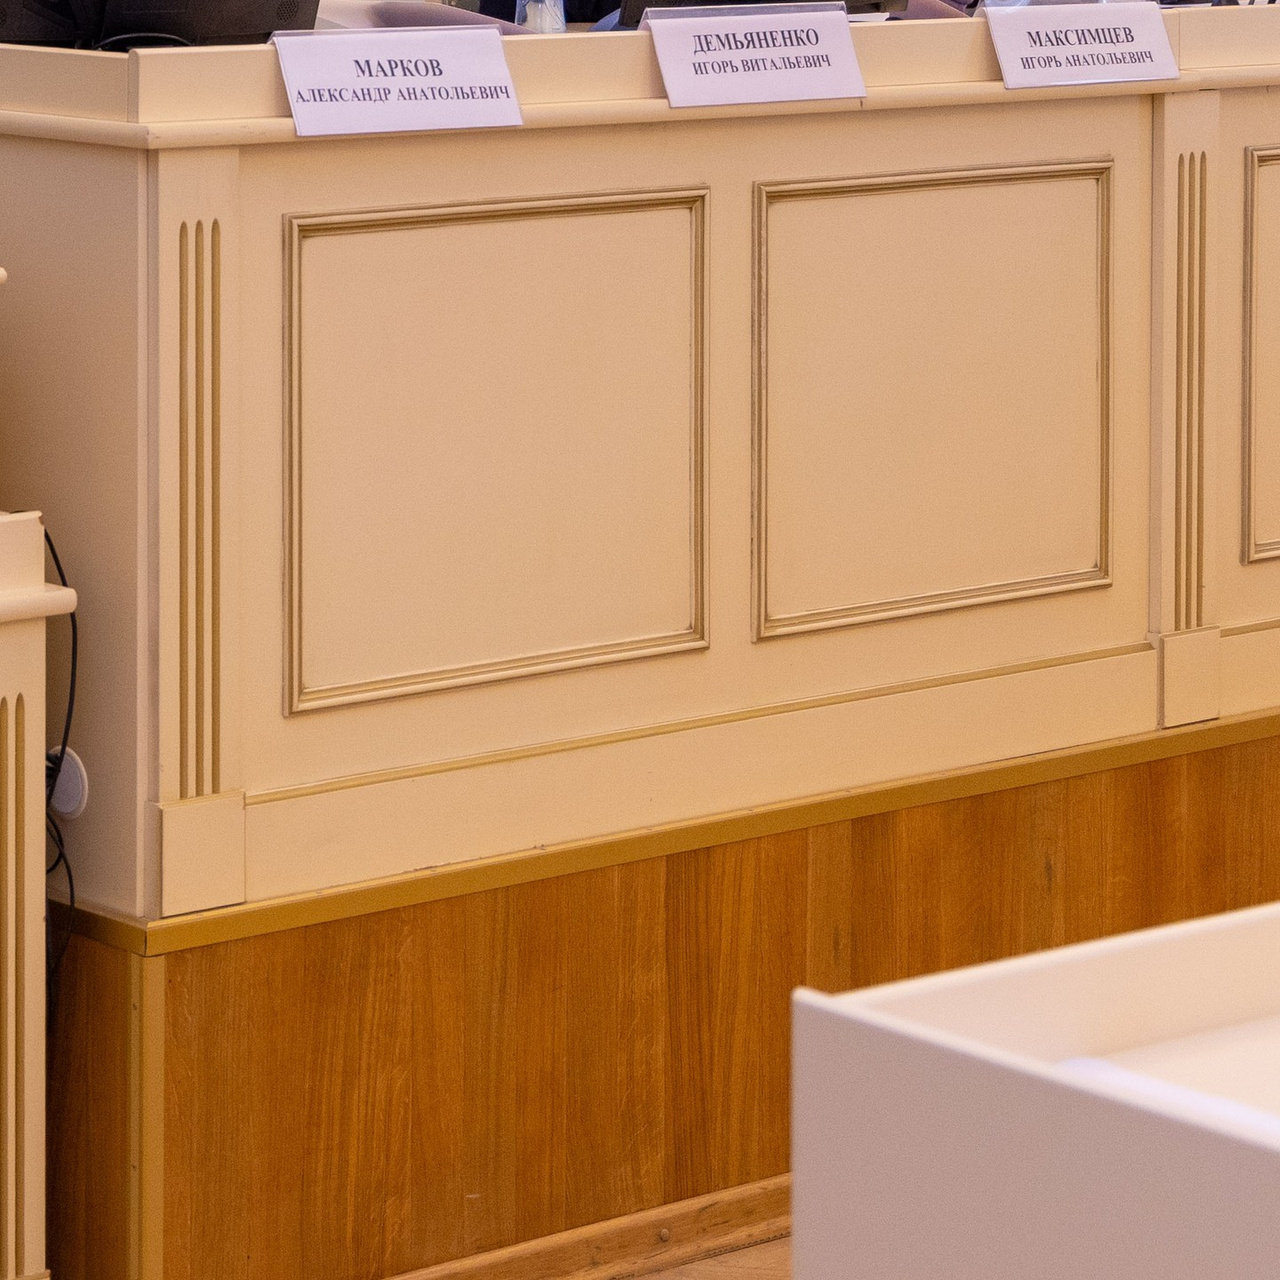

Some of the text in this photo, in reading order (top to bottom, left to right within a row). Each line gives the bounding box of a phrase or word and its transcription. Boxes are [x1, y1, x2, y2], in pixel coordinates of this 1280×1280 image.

[692, 27, 820, 55] ДЕМЬЯНЕНКО
[1026, 26, 1135, 48] МАКСИМЦЕВ
[353, 58, 443, 78] МАРКОВ
[692, 54, 831, 75] ИГОРЬ ВИТАЛЬЕВИЧ
[1020, 50, 1154, 70] ИГОРЬ АНАТОЛЬЕВИЧ
[295, 85, 511, 104] АЛЕКСАНДР АНАТОЛЬЕВИЧ
